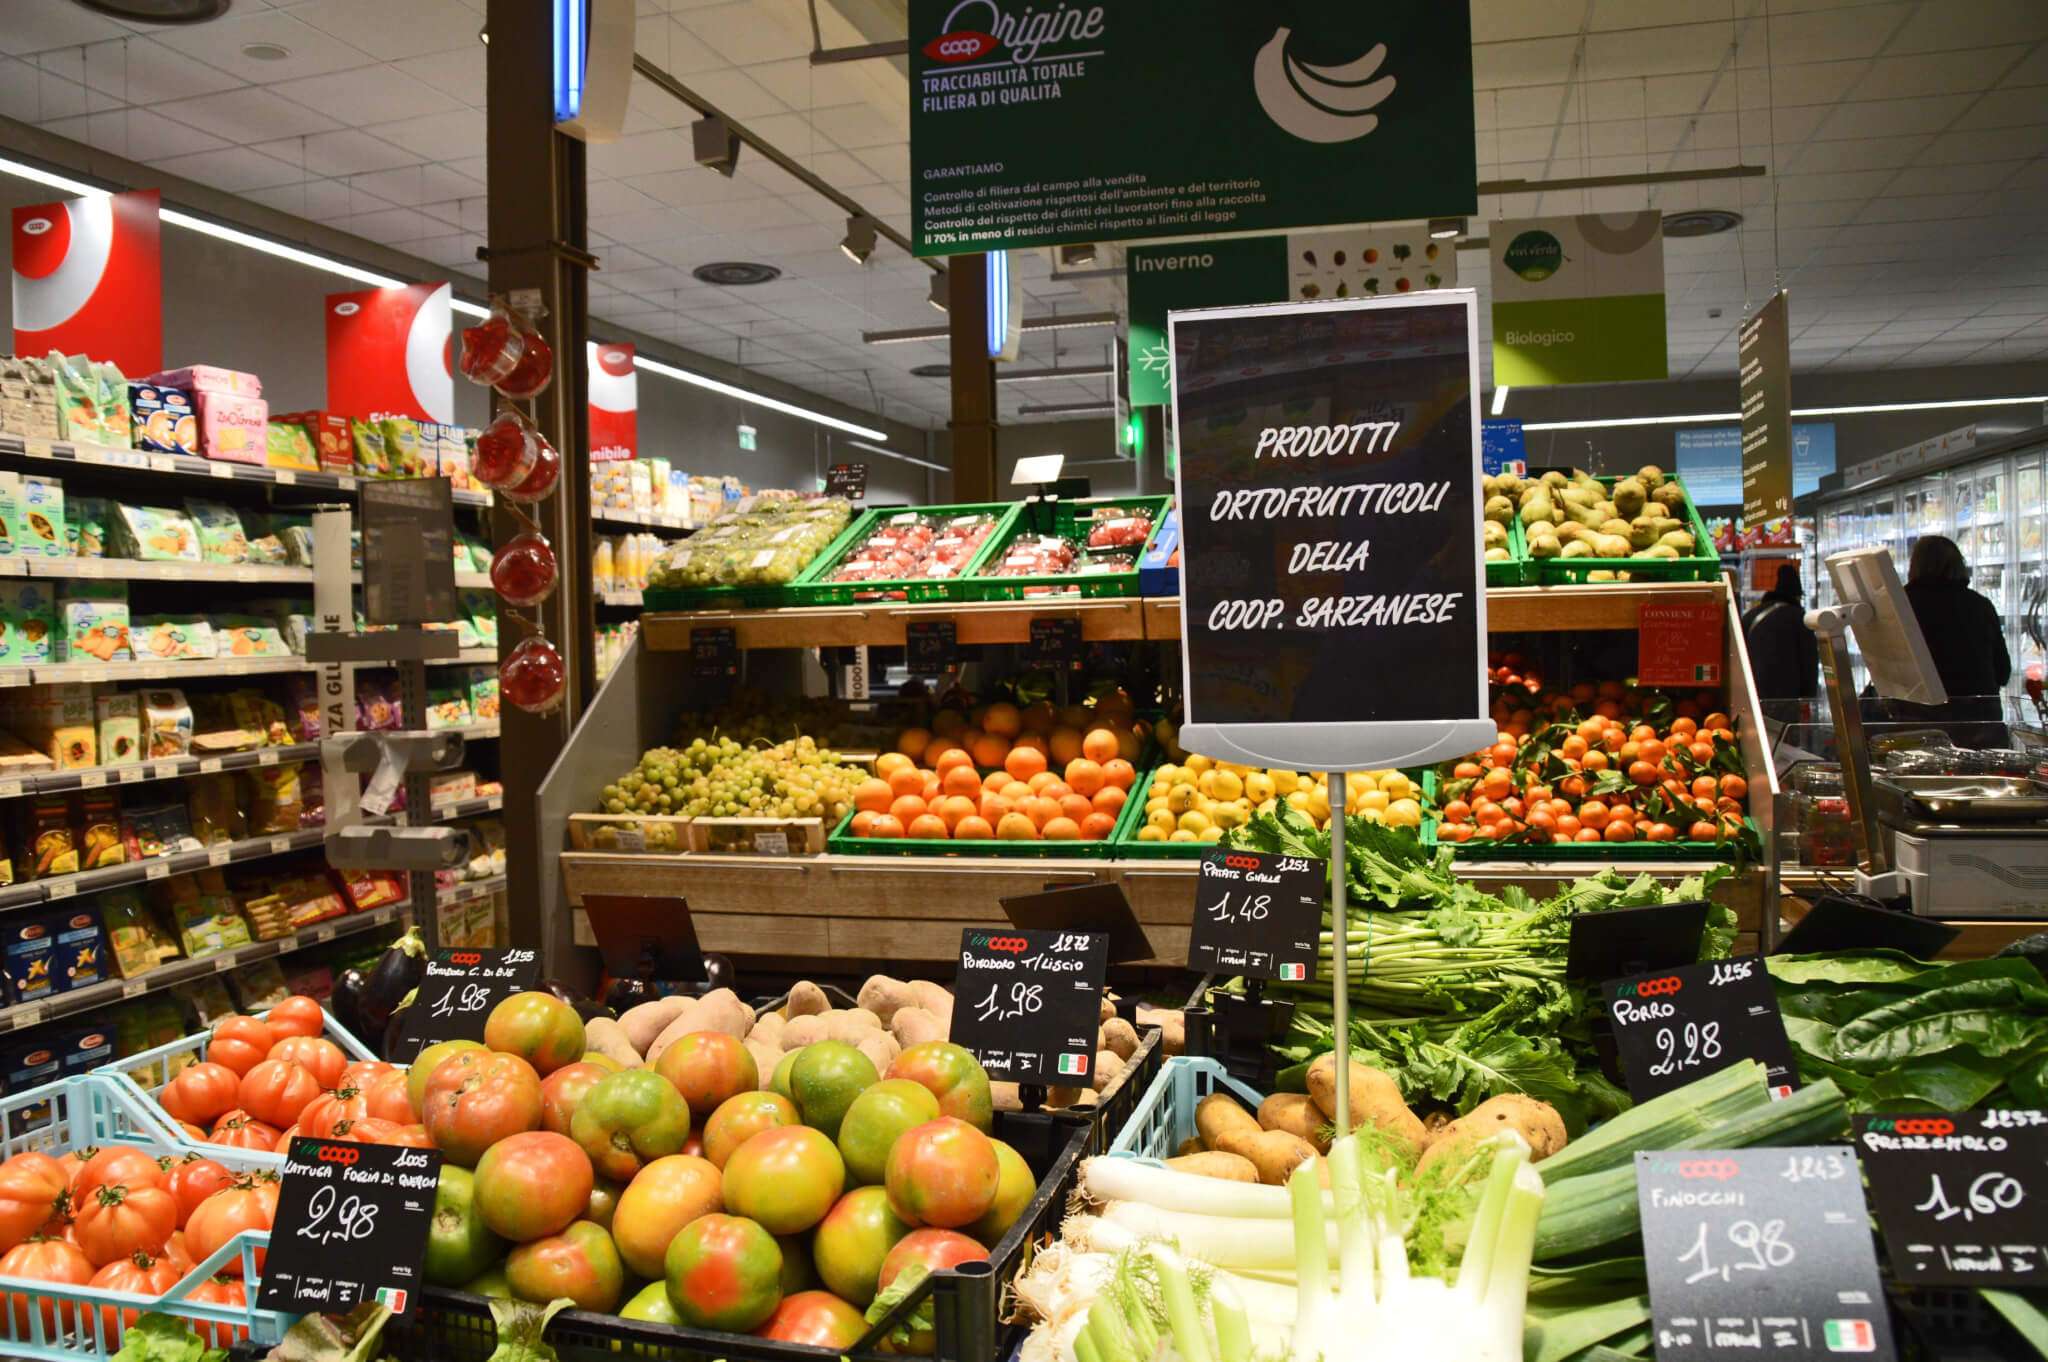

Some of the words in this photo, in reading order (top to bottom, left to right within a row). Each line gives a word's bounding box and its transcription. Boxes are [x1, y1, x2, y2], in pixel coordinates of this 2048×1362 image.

[939, 38, 980, 55] coop
[941, 0, 1105, 64] Origine
[922, 66, 1028, 93] TRACCIABILITÀ
[1032, 62, 1085, 81] TOTALE
[923, 94, 976, 112] FILIERA
[981, 91, 995, 105] DI
[1000, 82, 1061, 104] QUALITÀ
[923, 162, 1004, 179] GARANTIAMO
[924, 189, 973, 202] Controllo
[976, 188, 987, 197] di
[989, 185, 1020, 196] filiera
[1023, 182, 1040, 193] dal
[1042, 180, 1079, 195] campo
[1082, 177, 1102, 188] alla
[1105, 174, 1146, 186] vendita
[924, 203, 962, 216] Metodi
[965, 202, 975, 212] di
[977, 197, 1042, 211] coltivazione
[1045, 191, 1097, 206] rispettosi
[1100, 185, 1175, 200] dell'ambiente
[1188, 182, 1206, 193] del
[1209, 177, 1261, 192] territorio
[924, 216, 974, 231] Controllo
[977, 215, 994, 226] del
[996, 210, 1038, 225] rispetto
[1041, 209, 1058, 220] dei
[1061, 206, 1092, 218] diritti
[1094, 203, 1111, 215] dei
[1114, 200, 1168, 213] lavoratori
[1171, 198, 1193, 209] fino
[1195, 195, 1216, 207] alla
[1219, 192, 1266, 205] raccolta
[924, 234, 932, 245] Il
[934, 231, 956, 244] 70%
[958, 230, 969, 241] in
[971, 229, 1001, 240] meno
[1004, 227, 1015, 238] di
[1017, 224, 1054, 237] residui
[1056, 220, 1097, 233] chimici
[1099, 217, 1143, 231] rispetto
[1146, 214, 1156, 225] ai
[1159, 213, 1188, 225] limiti
[1191, 210, 1201, 222] di
[1204, 209, 1237, 223] legge
[1135, 252, 1213, 272] Inverno
[1505, 330, 1575, 346] Biologico
[1255, 421, 1400, 459] PRODOTTI
[1210, 481, 1450, 521] ORTOFRUTTICOLI
[1288, 540, 1369, 574] DELLA
[1208, 599, 1284, 631] COOP.
[1296, 592, 1463, 628] SARZANESE
[1275, 858, 1310, 872] 1251
[1208, 891, 1271, 923] 1,48
[501, 949, 535, 965] 1255
[1050, 933, 1090, 952] 1272
[1708, 961, 1753, 986] 1256
[431, 983, 491, 1018] 1,98
[974, 982, 1043, 1021] 1,98
[1649, 1021, 1722, 1076] 2,28
[284, 1160, 332, 1179] LATTUGA
[392, 1148, 428, 1168] 1005
[1781, 1155, 1845, 1183] 1243
[1651, 1188, 1745, 1209] FINOCCHI
[1914, 1172, 2023, 1222] 1,60
[297, 1185, 379, 1245] 2,98
[1677, 1218, 1796, 1285] 1,98
